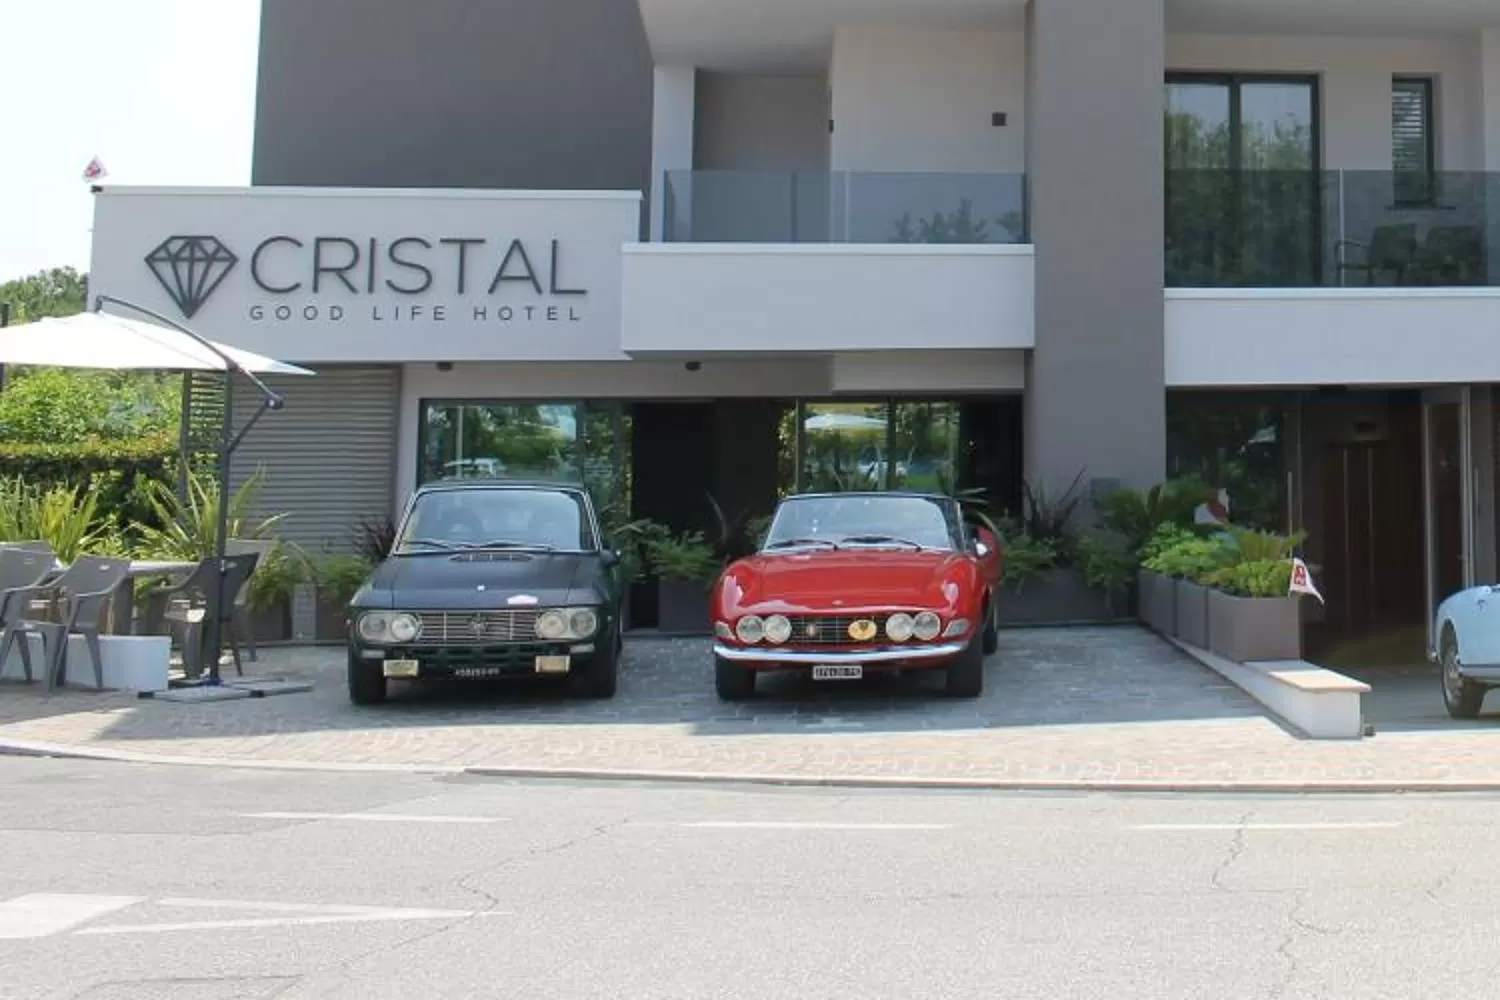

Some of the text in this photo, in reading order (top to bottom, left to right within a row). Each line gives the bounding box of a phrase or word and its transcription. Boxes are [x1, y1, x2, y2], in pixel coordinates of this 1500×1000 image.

[249, 235, 589, 297] CRISTAL
[249, 305, 581, 321] GOOD LIFE HOTEL
